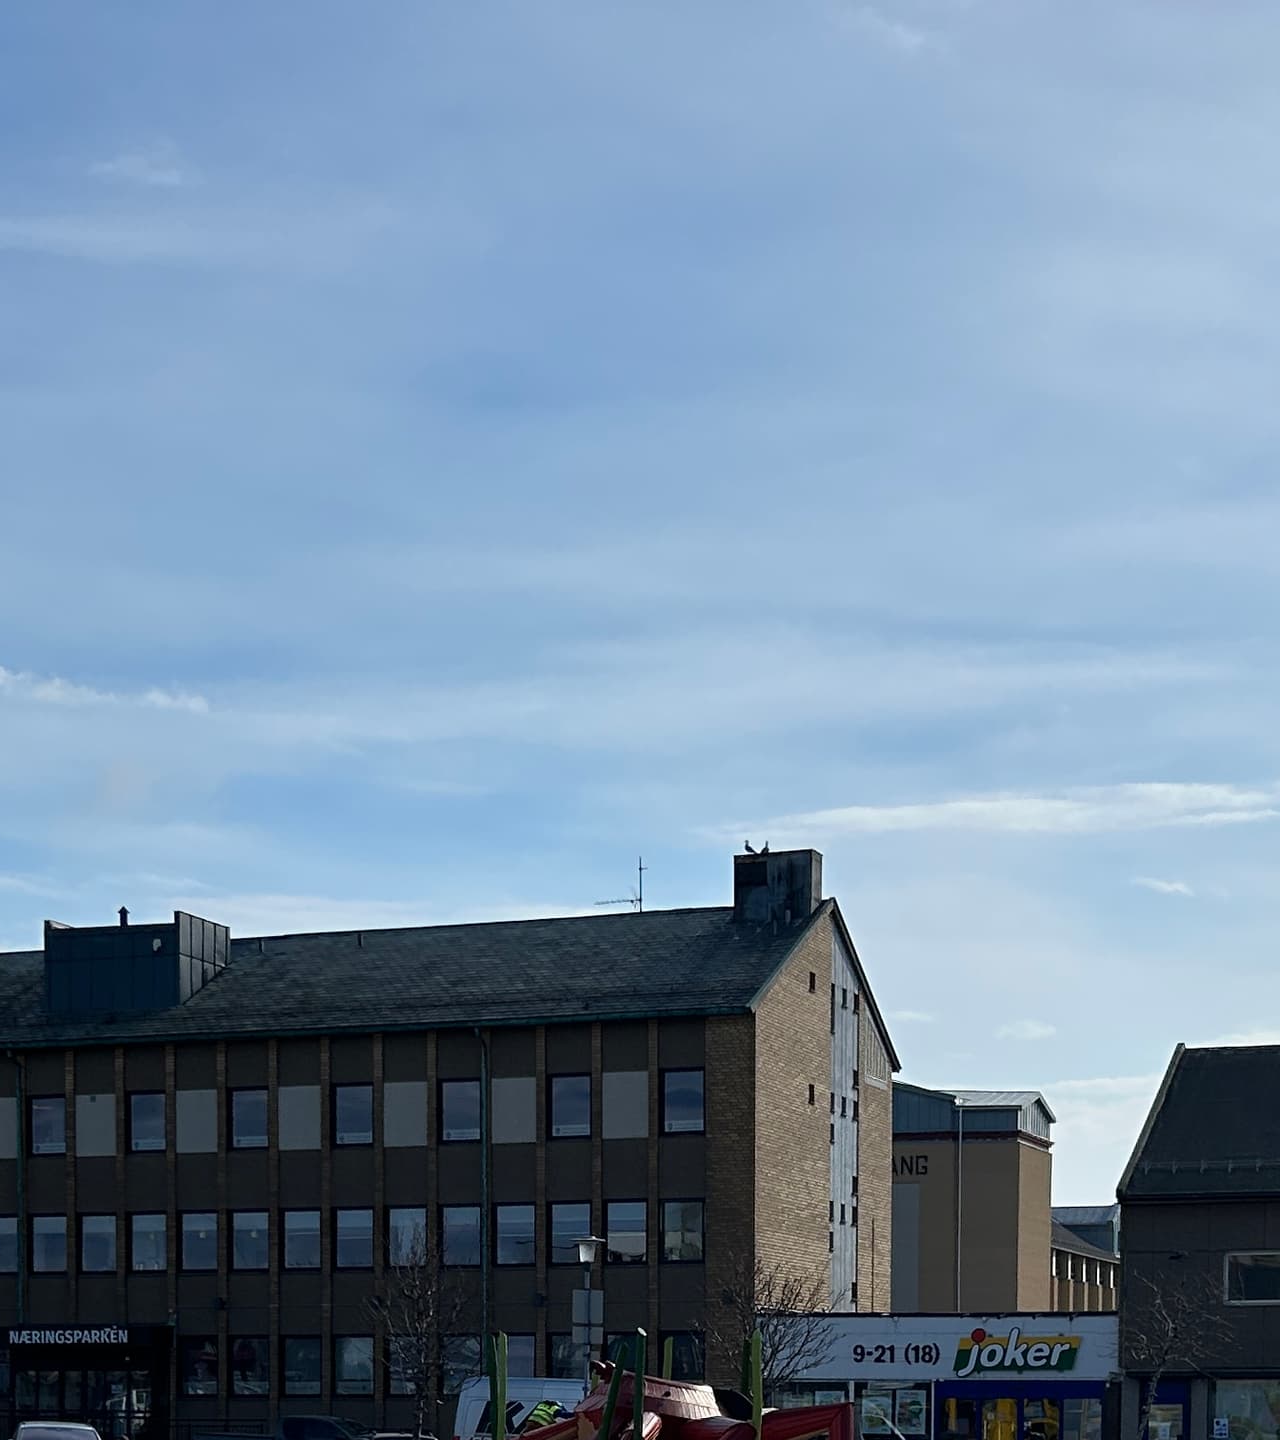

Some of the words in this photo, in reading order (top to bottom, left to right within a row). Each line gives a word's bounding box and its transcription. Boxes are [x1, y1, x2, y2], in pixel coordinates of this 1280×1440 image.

[9, 1329, 128, 1344] NÆRINGSPARKEN
[853, 1344, 895, 1363] 9-21
[904, 1342, 940, 1365] (18)
[956, 1327, 1070, 1377] joker
